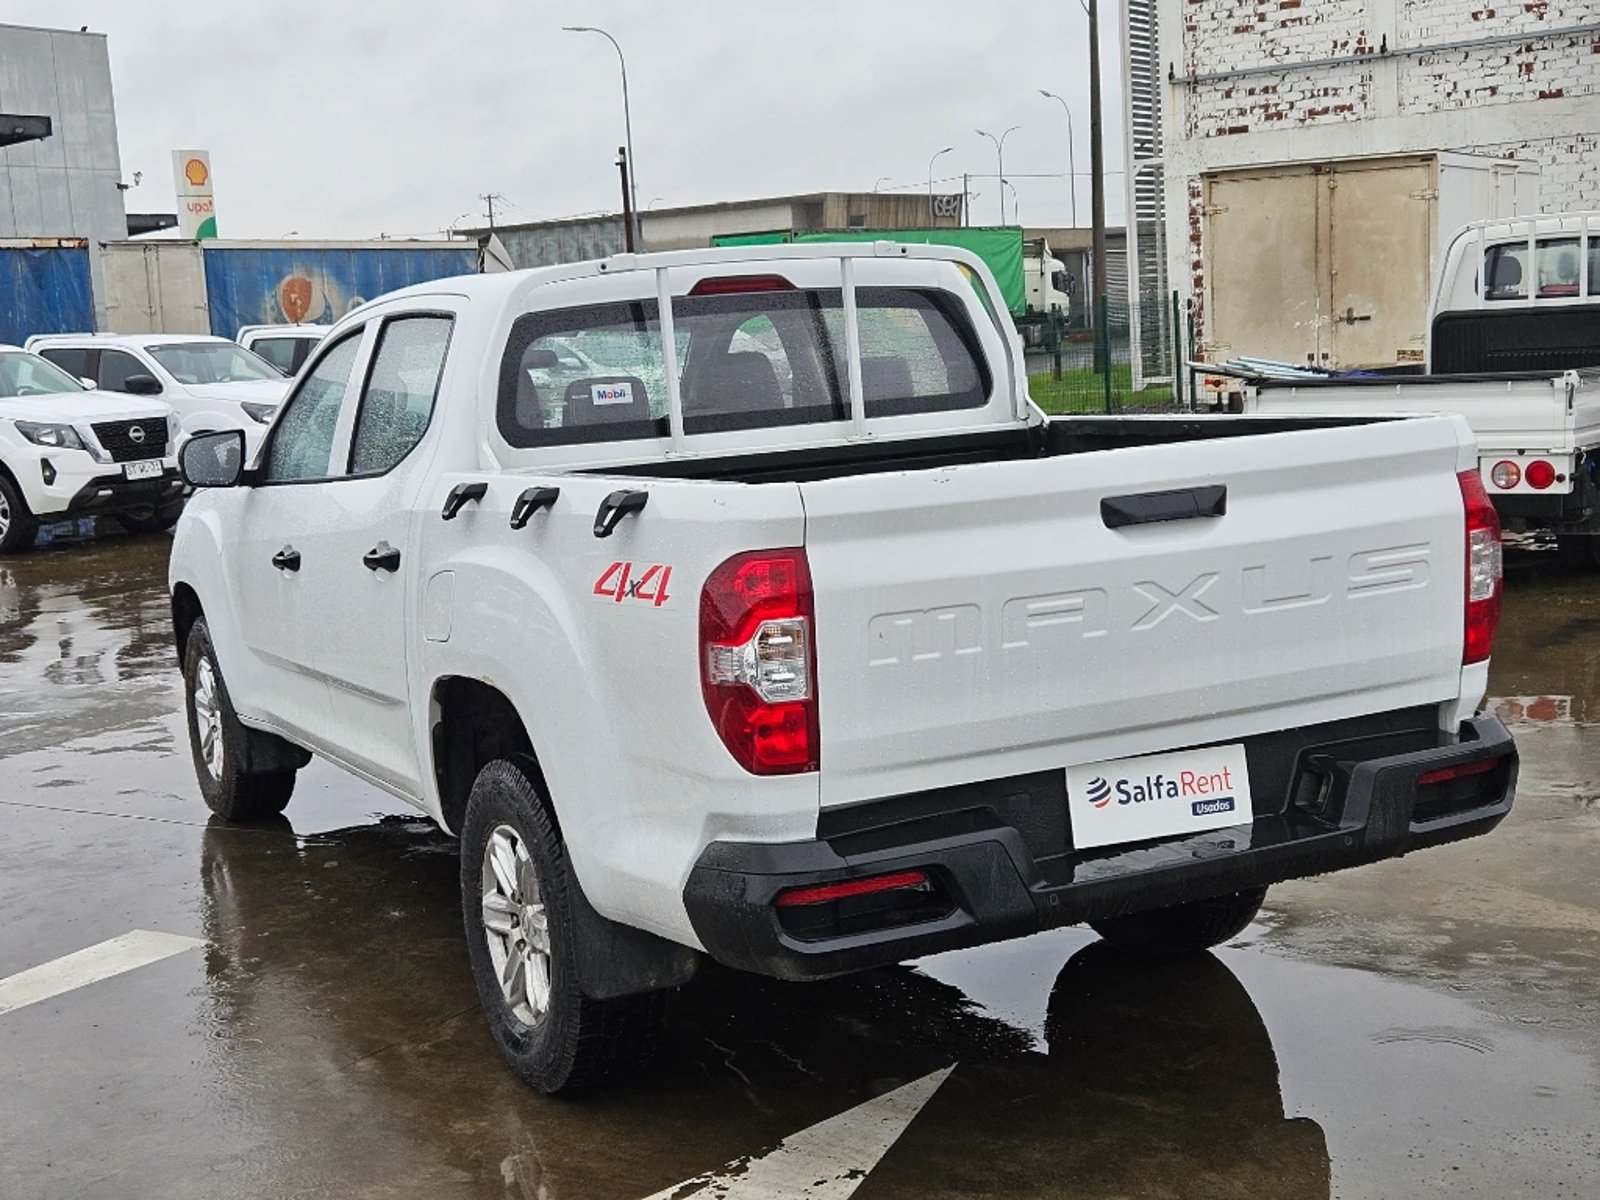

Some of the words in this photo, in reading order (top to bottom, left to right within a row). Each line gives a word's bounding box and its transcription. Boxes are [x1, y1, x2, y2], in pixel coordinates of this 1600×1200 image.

[187, 200, 213, 215] upa!
[597, 389, 626, 400] Mobil
[594, 562, 672, 607] 4x4
[869, 542, 1431, 666] MAXUS
[1116, 766, 1233, 805] SalfaRent
[1196, 801, 1230, 814] Usados
